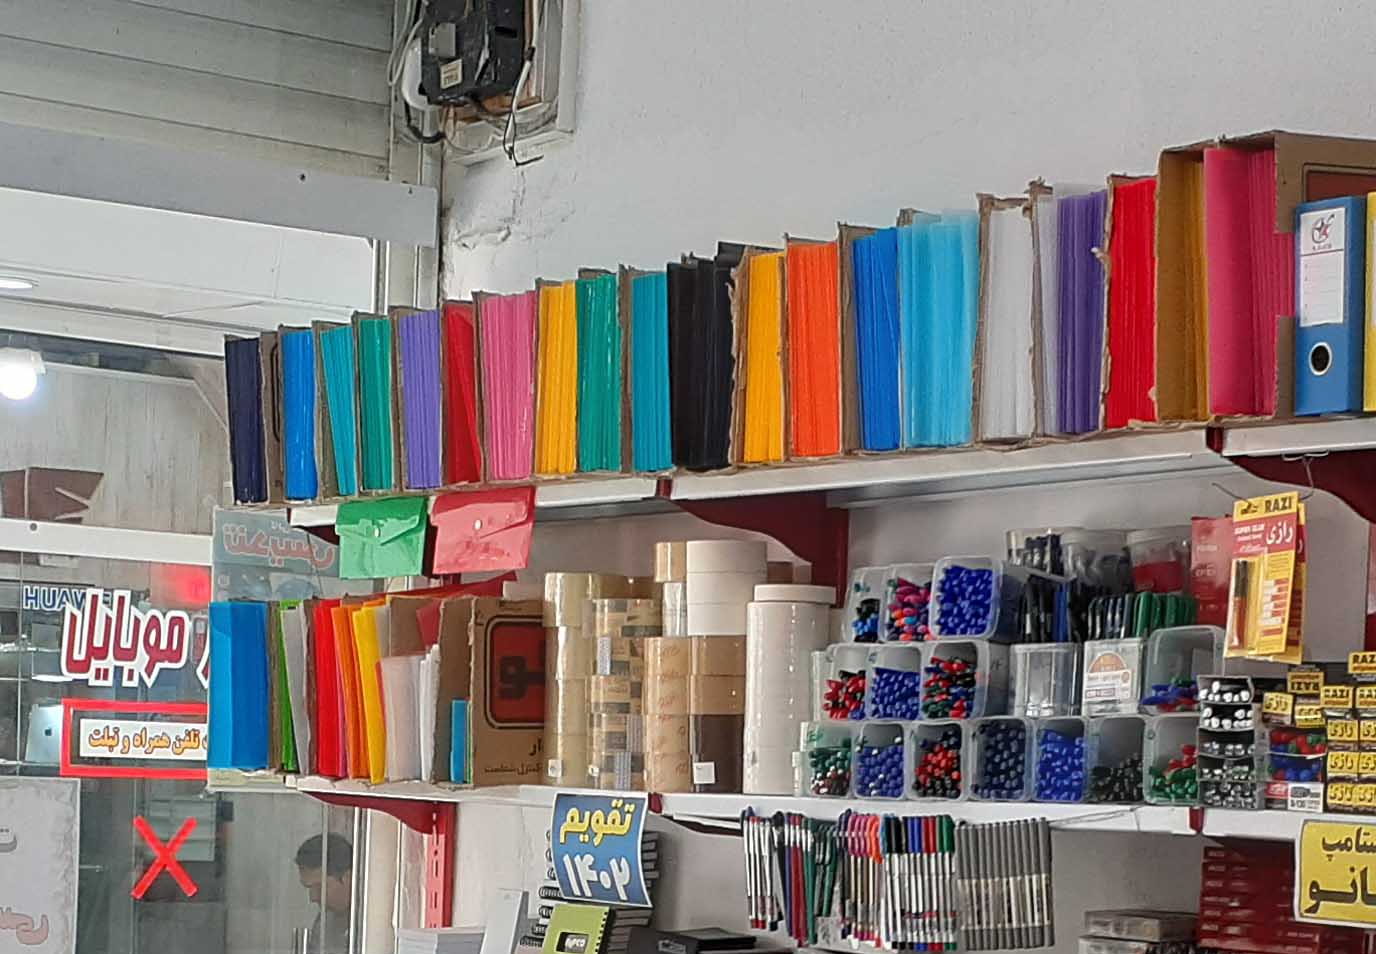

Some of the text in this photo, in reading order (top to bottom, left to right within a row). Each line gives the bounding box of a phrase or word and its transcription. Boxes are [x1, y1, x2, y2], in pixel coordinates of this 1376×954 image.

[1263, 495, 1293, 513] RAZI
[1265, 520, 1294, 545] رازی
[61, 589, 190, 688] موبایل
[88, 726, 120, 753] تبلت
[121, 733, 130, 753] و
[133, 726, 171, 752] همراه
[172, 729, 200, 755] تلفن
[559, 800, 634, 847] تقویم
[562, 851, 631, 900] ۱۴۰۲
